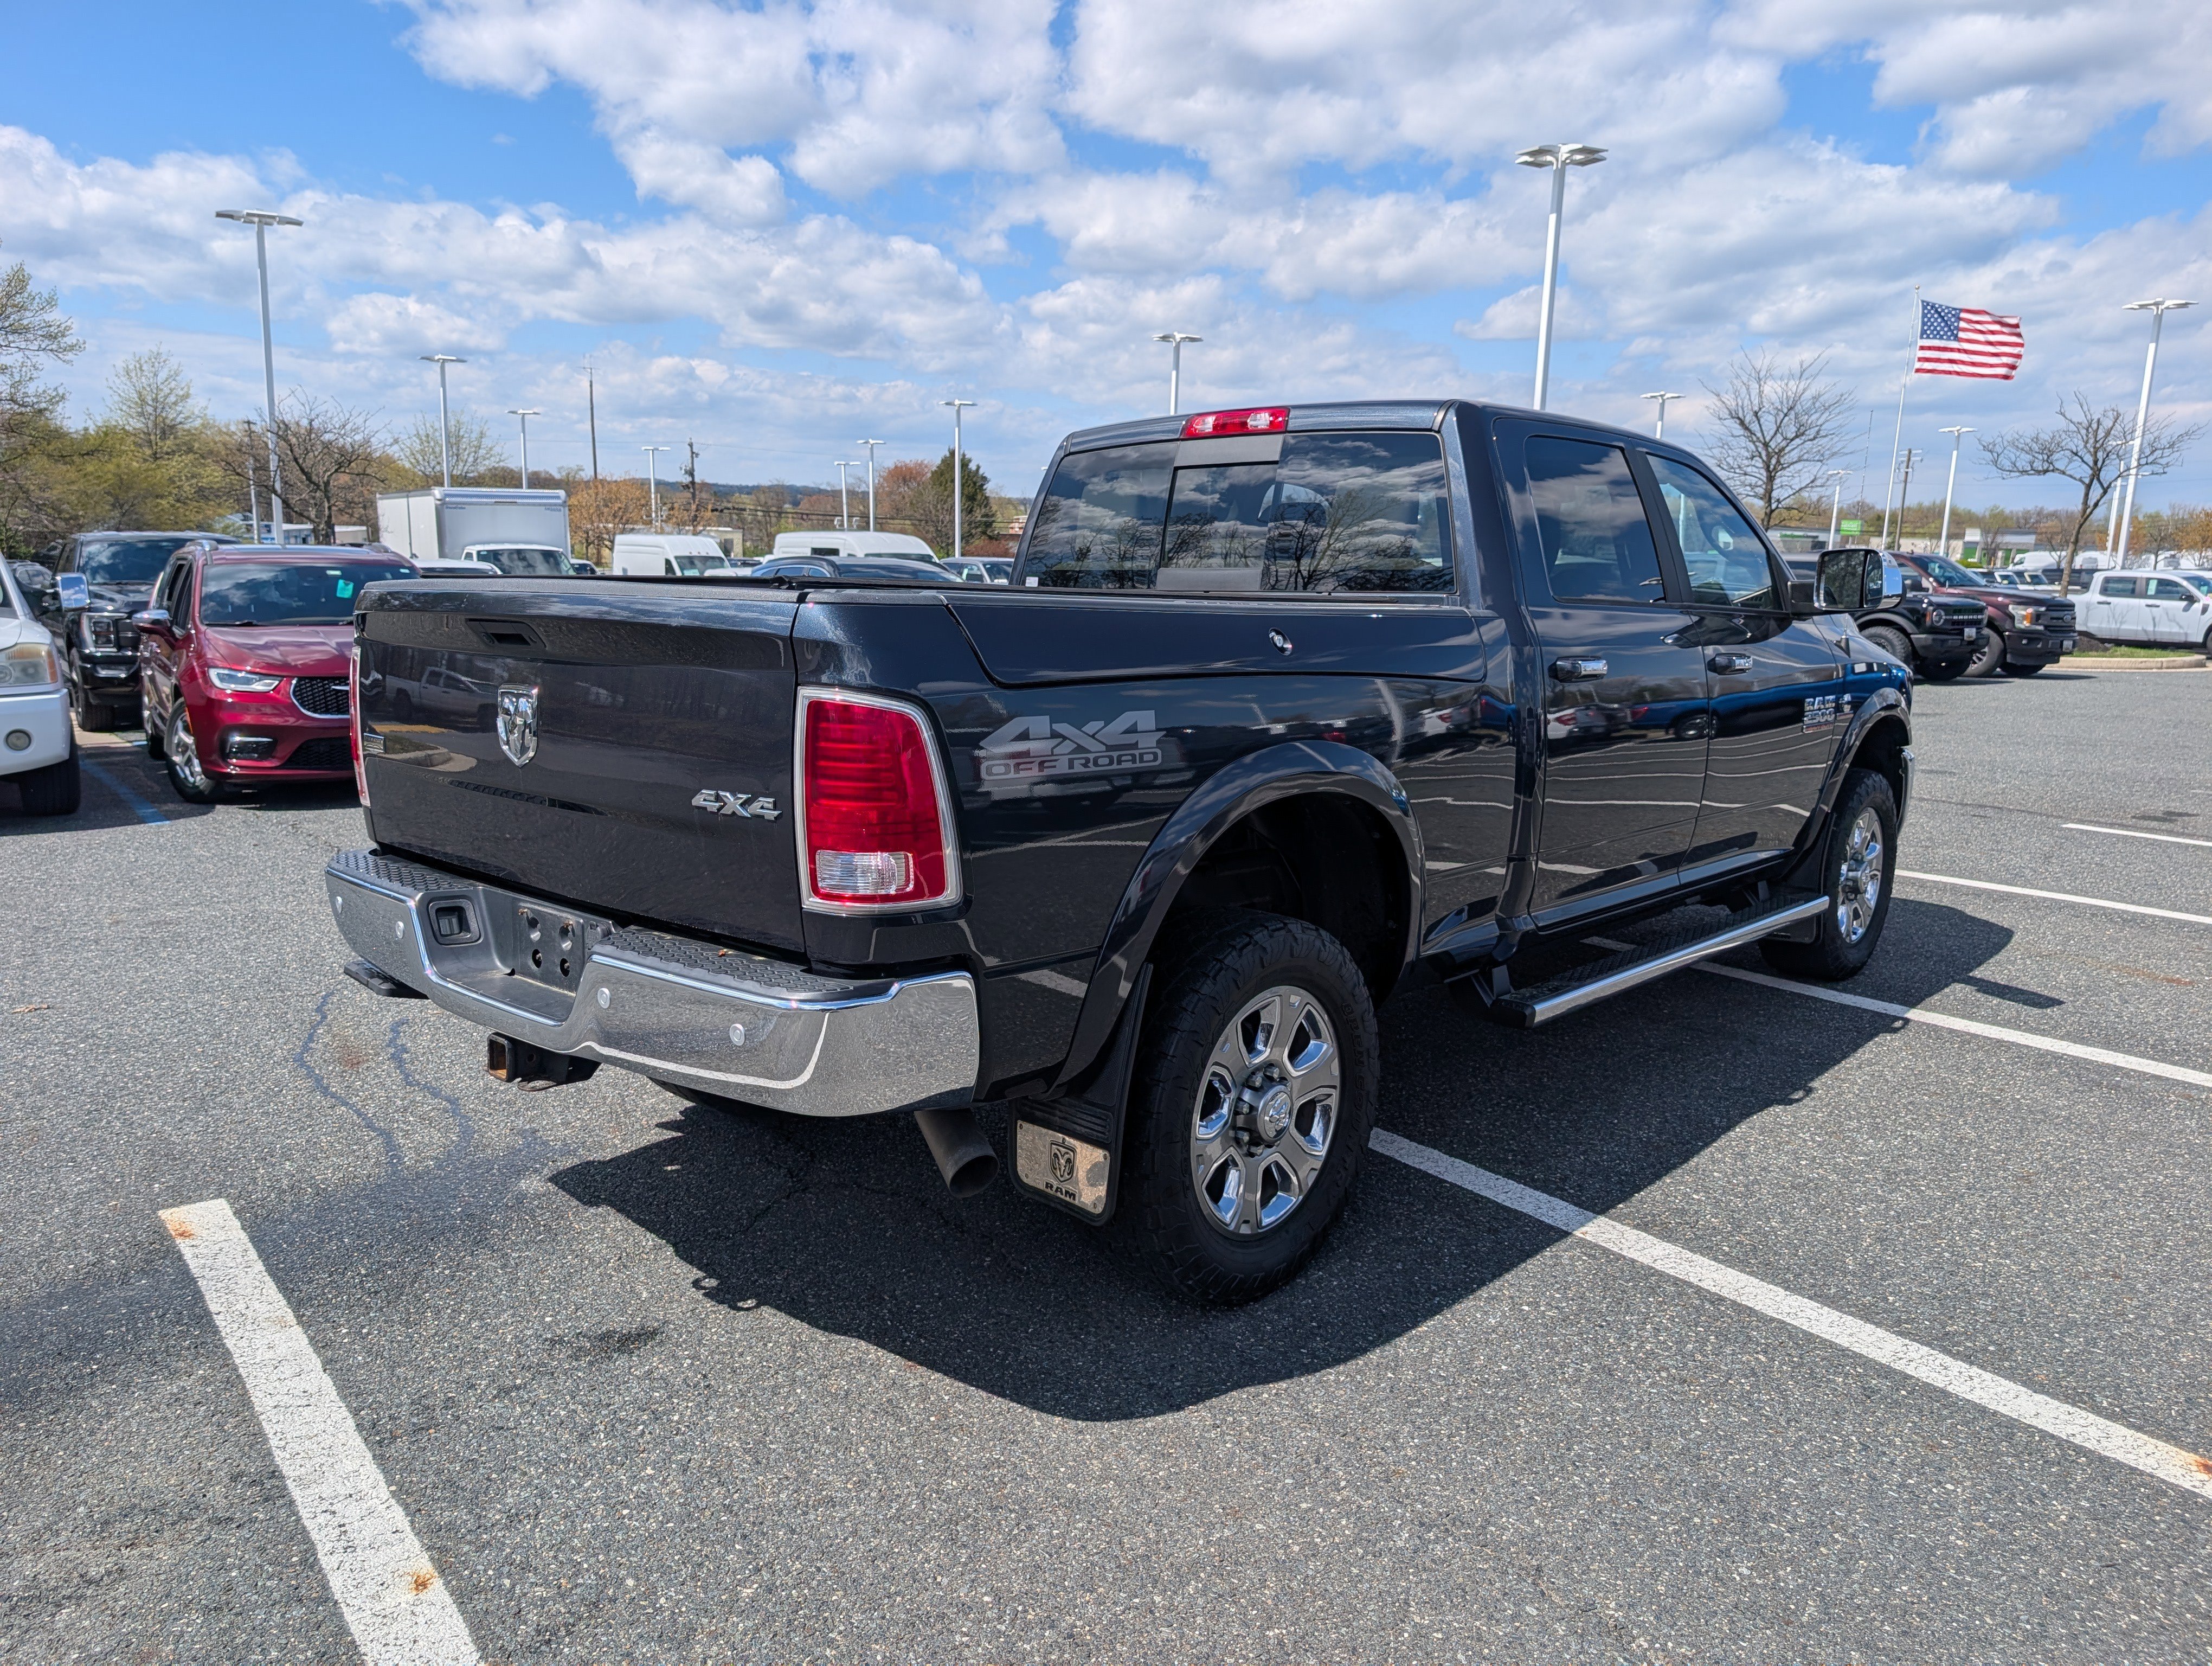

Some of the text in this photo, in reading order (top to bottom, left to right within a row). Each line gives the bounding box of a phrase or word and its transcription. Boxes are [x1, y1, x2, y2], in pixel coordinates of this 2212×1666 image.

[1804, 695, 1836, 711] RAM
[1804, 708, 1836, 725] 2500
[985, 751, 1159, 777] OFF ROAD
[1044, 1181, 1077, 1202] RAM
